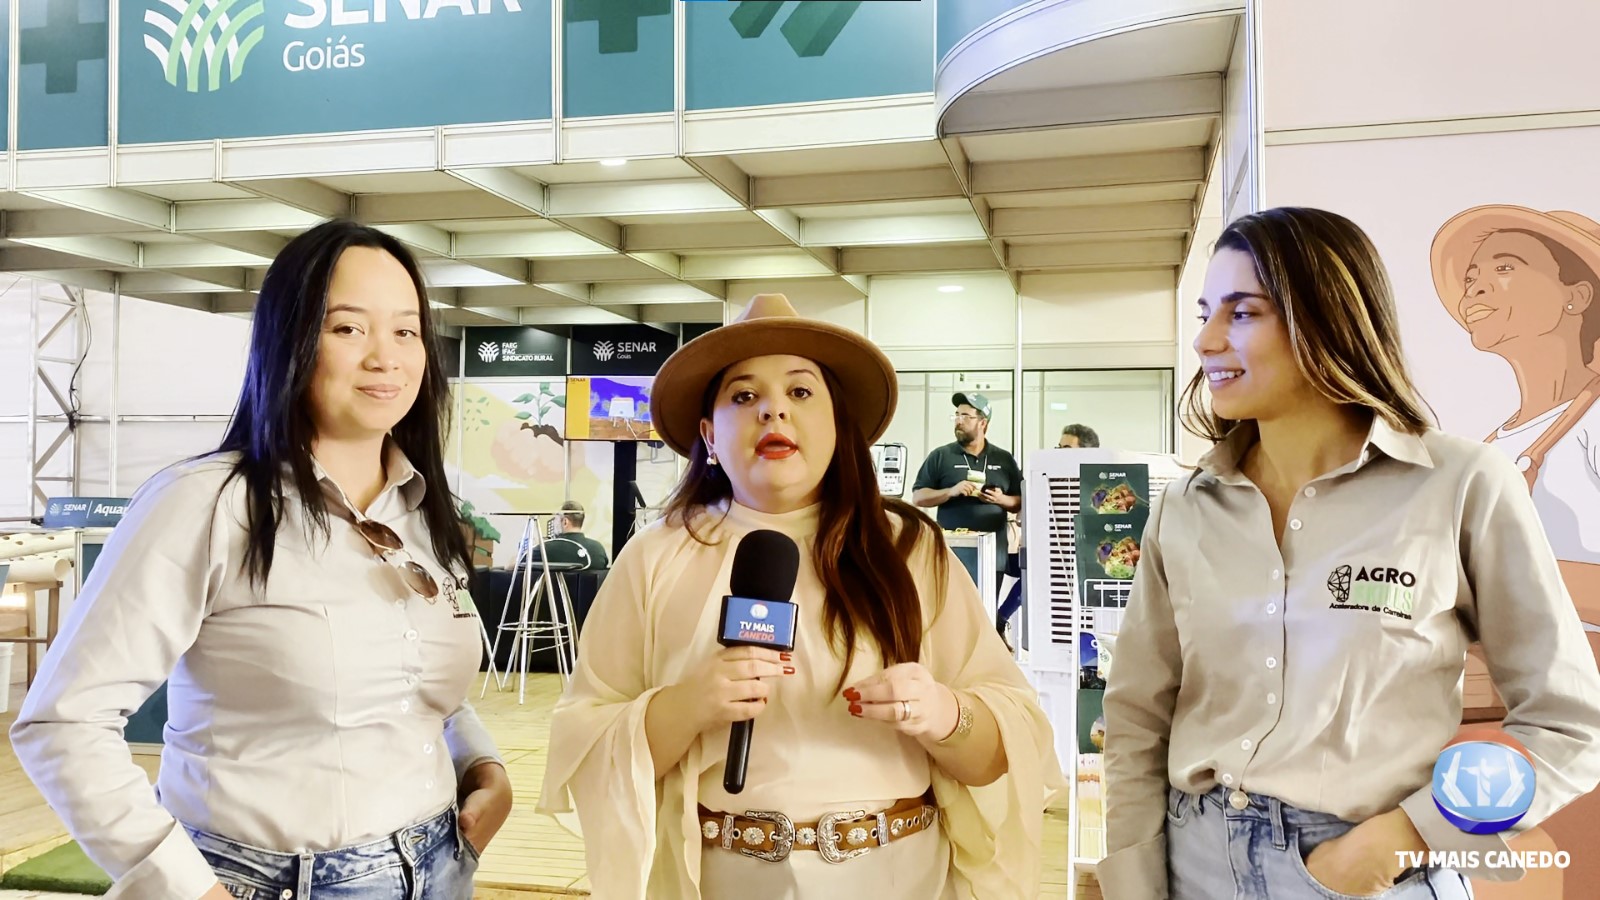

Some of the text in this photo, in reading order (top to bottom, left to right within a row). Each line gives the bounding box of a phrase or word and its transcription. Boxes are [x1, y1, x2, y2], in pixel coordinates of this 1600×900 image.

[283, 35, 366, 72] Goiás
[617, 342, 656, 352] SENAR
[1355, 566, 1416, 587] AGRO
[1383, 607, 1411, 620] Carreiras
[740, 621, 774, 632] TV MAIS
[739, 631, 775, 641] CANEDO
